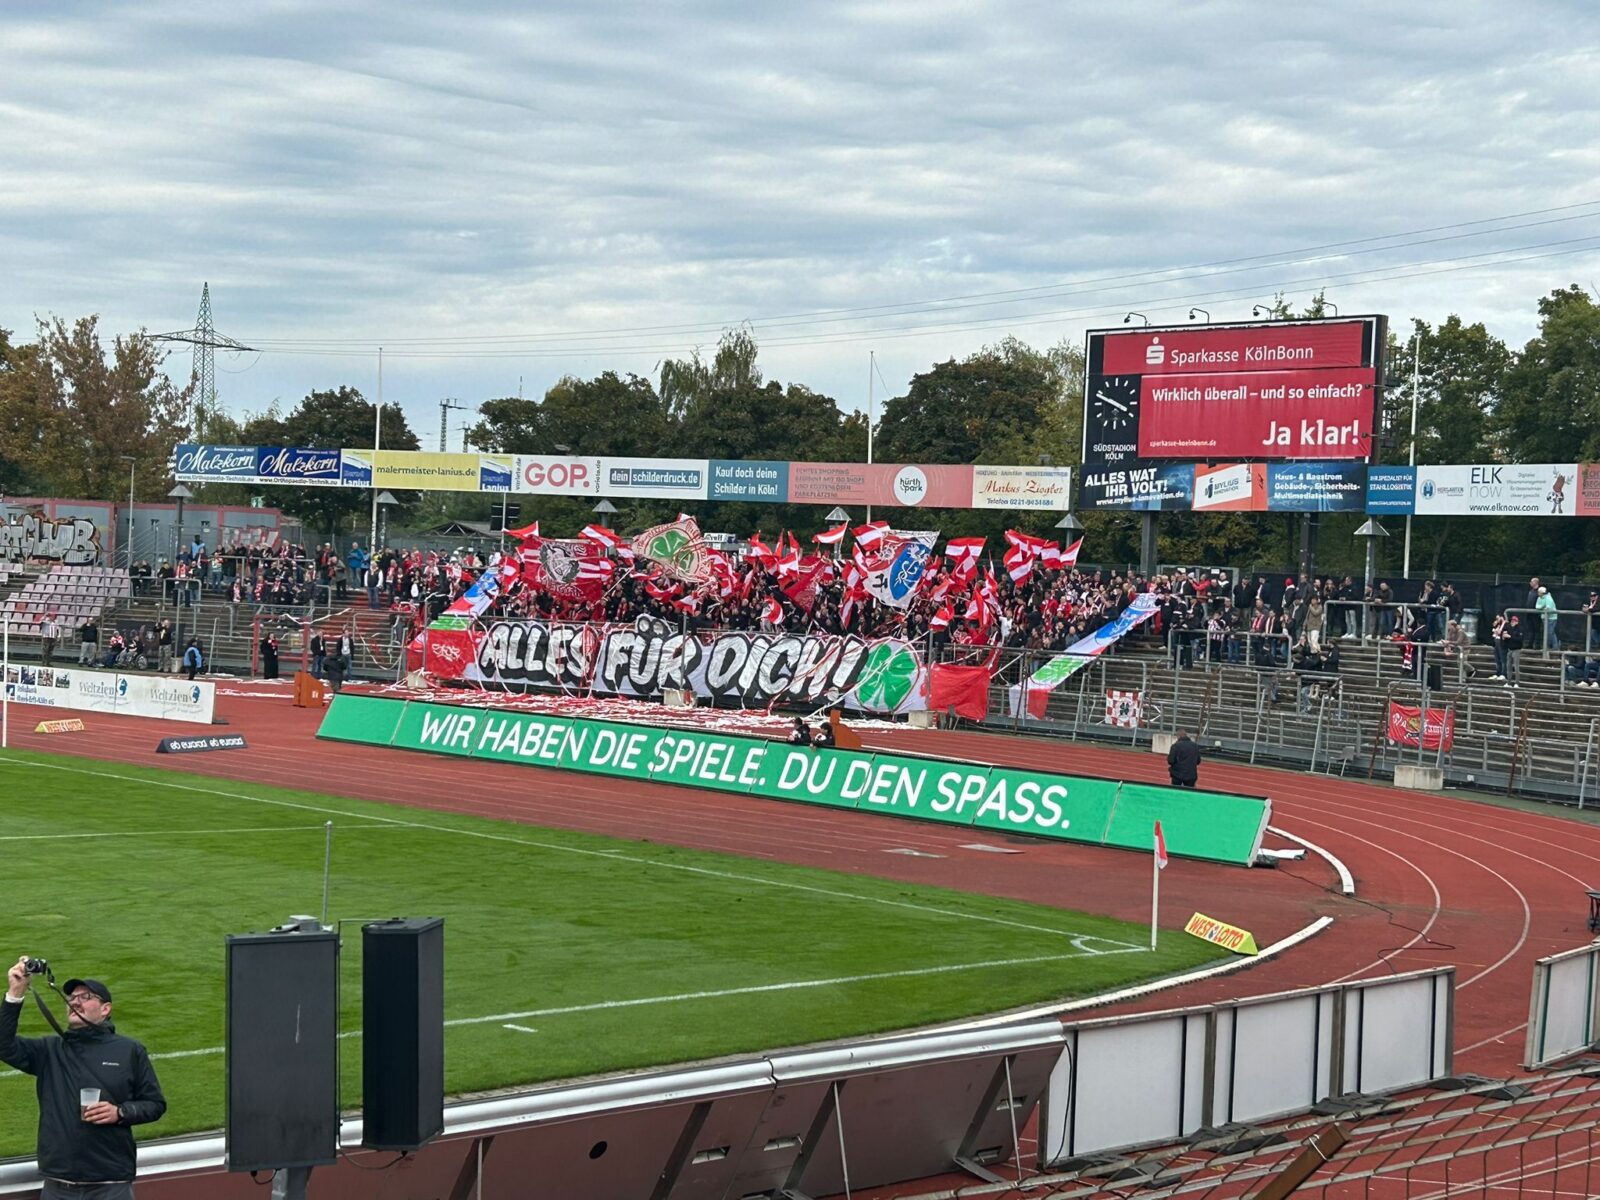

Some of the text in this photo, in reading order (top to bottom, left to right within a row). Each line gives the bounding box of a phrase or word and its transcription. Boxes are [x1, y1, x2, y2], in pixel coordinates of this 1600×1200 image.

[1170, 346, 1313, 364] Sparkasse KölnBonn
[1152, 386, 1201, 402] Wirklich
[1204, 385, 1247, 400] überall
[1261, 383, 1285, 399] und
[1288, 386, 1303, 398] so
[1307, 383, 1362, 398] einfach?
[1262, 419, 1359, 446] Ja klar!
[1093, 443, 1136, 452] SÜDSTADION
[1105, 452, 1124, 460] KÖLN
[178, 446, 254, 473] Malzkorn
[259, 448, 338, 476] Malzkorn
[524, 463, 590, 488] GOP.
[611, 471, 628, 482] dein
[632, 472, 698, 484] schilderdruck.de
[715, 466, 778, 479] Kauf doch deine
[1085, 468, 1157, 487] ALLES WAT
[1471, 467, 1503, 484] ELK
[714, 482, 778, 496] Schilder in Köln!
[979, 480, 1063, 496] Markus Ziegler
[1105, 480, 1168, 497] IHR VOLT!
[1470, 485, 1502, 498] now
[1469, 503, 1539, 512] www.elknow.com
[478, 614, 868, 703] ALLES FÜR DICH!
[79, 682, 115, 696] Weltzien
[151, 689, 188, 703] Weltzien
[420, 711, 1071, 829] WIR HABEN DIE SPIELE. DU DEN SPASS.
[1189, 916, 1244, 948] WEST LOTTO
